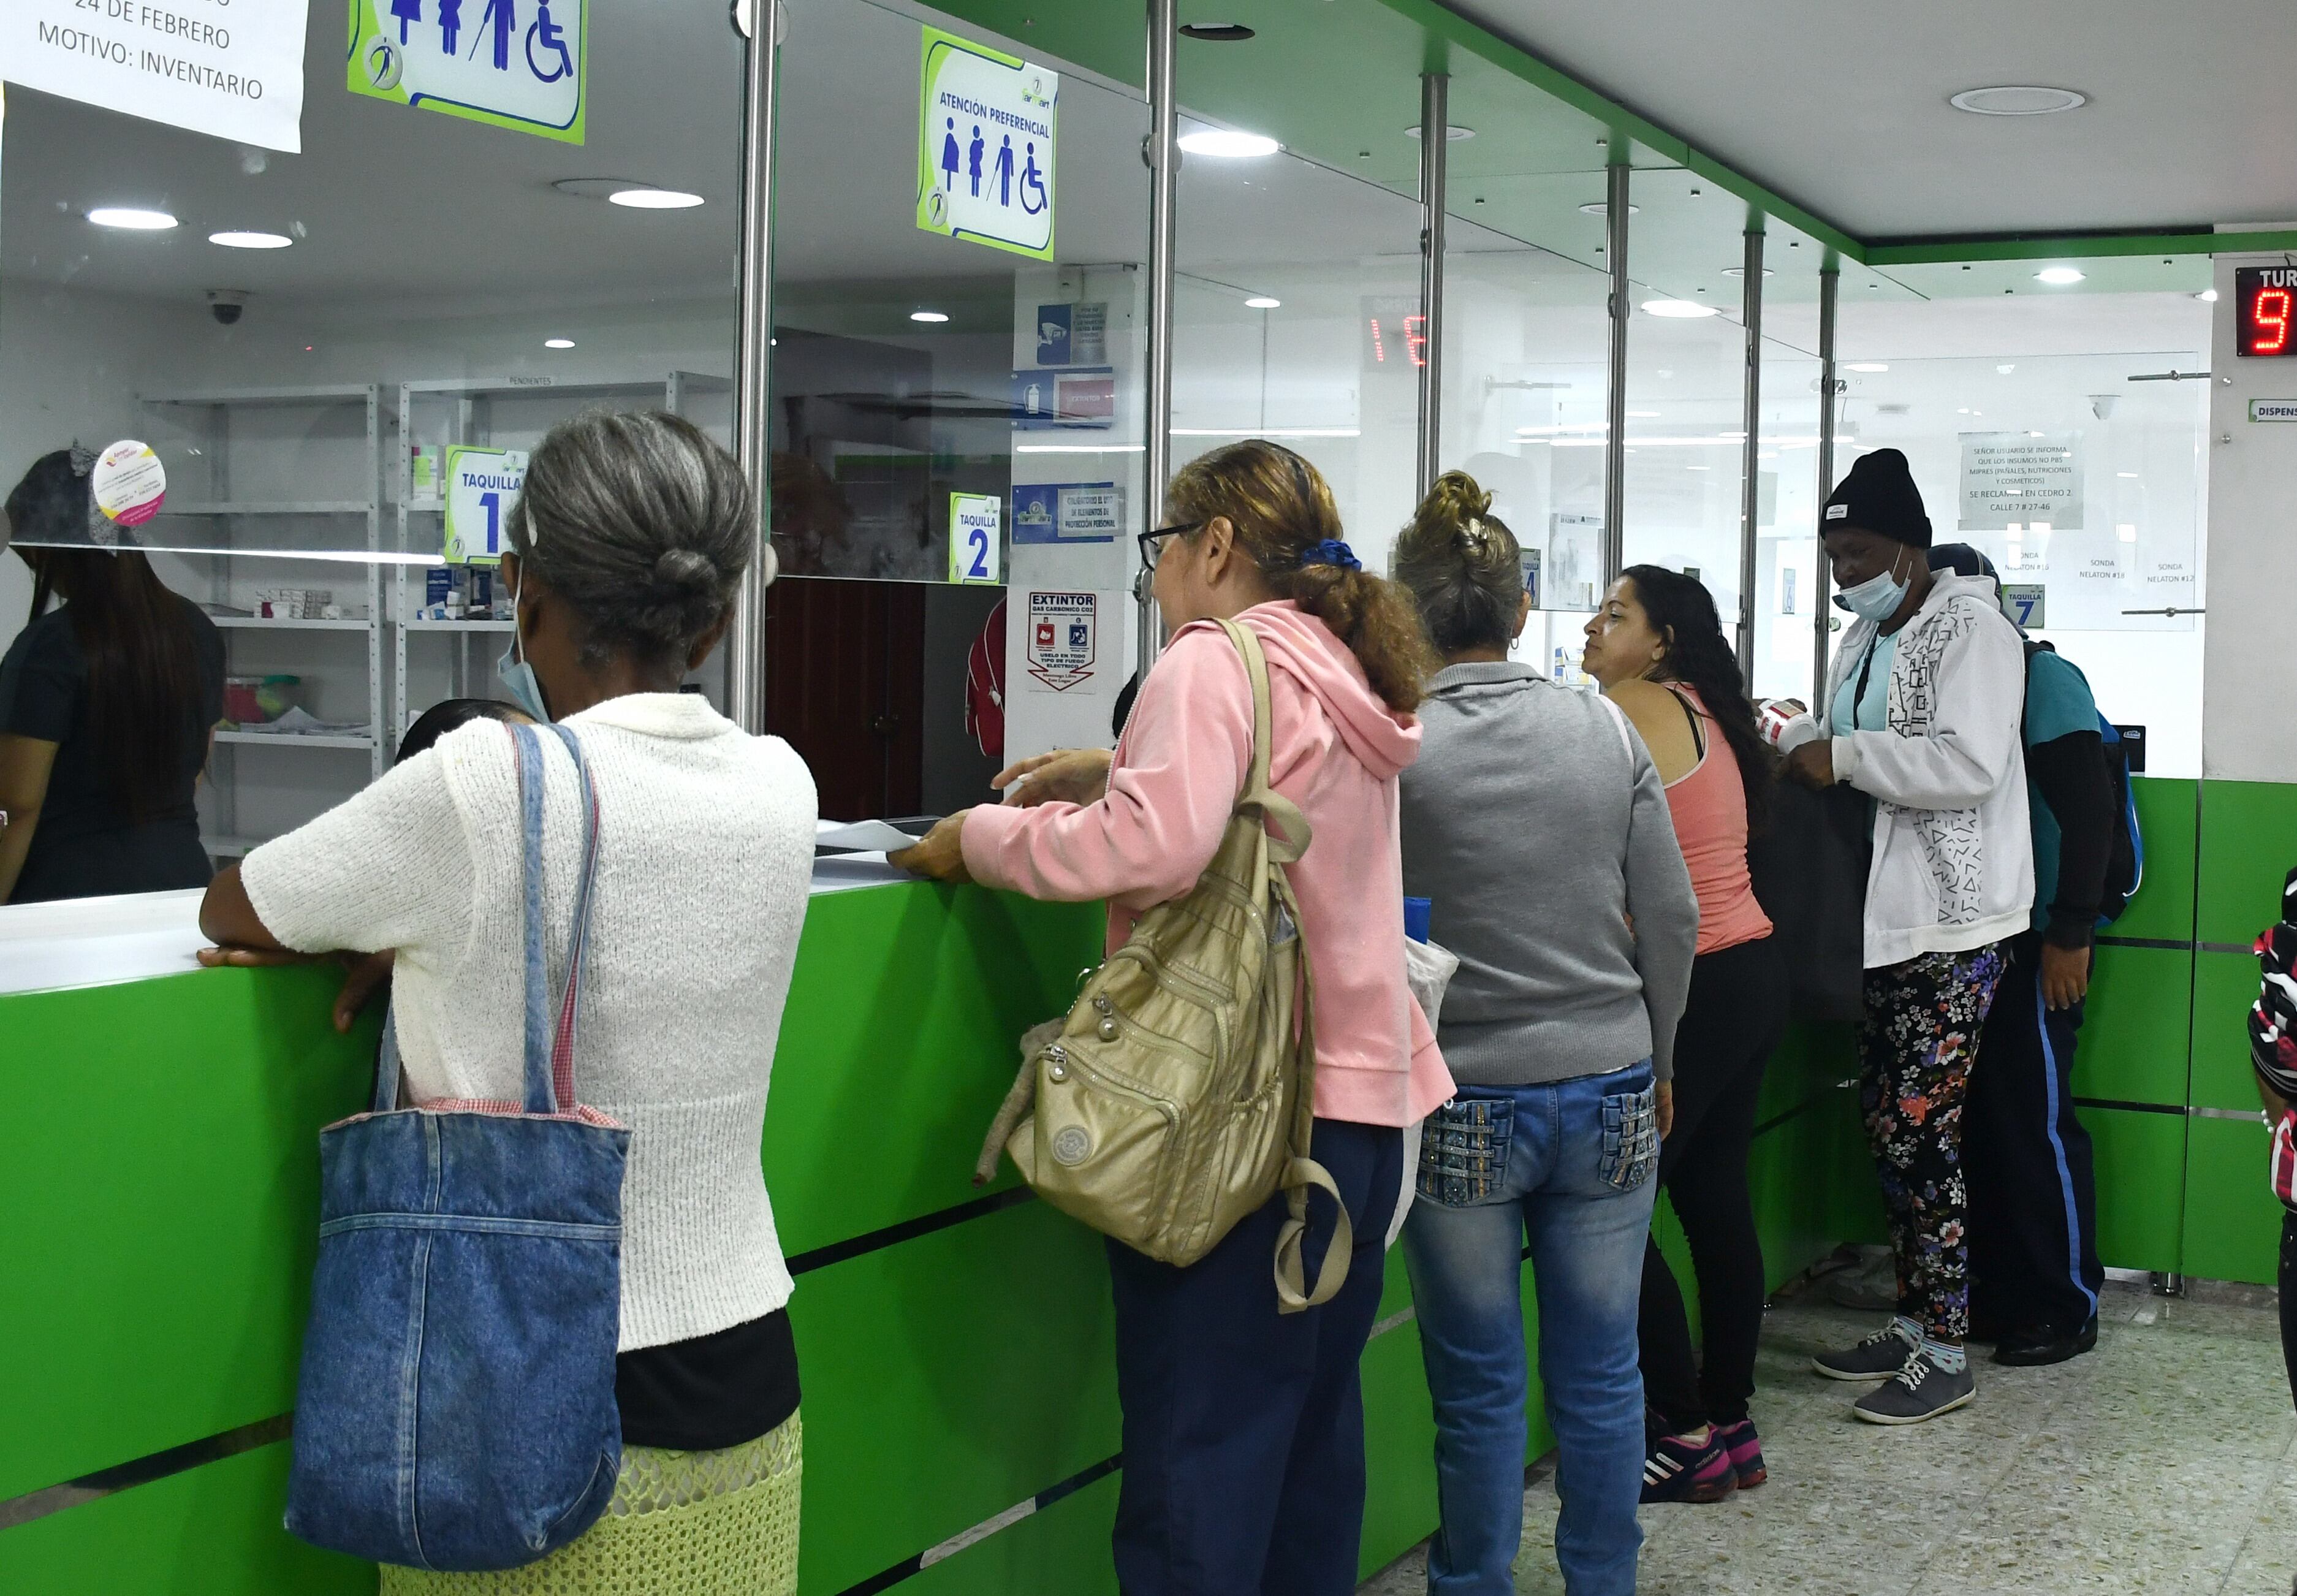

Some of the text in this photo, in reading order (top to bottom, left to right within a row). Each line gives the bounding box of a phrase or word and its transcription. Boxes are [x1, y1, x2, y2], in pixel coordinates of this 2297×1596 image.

[108, 0, 134, 22] DE
[142, 6, 229, 49] FEBRERO
[39, 21, 262, 99] MOTIVO: INVENTARIO
[940, 92, 1049, 139] ATENCIÓN PREFERENCIAL
[2259, 270, 2297, 287] TUR
[2256, 291, 2290, 349] 9
[463, 473, 521, 490] TAQUILLA
[479, 493, 499, 553] 1
[960, 514, 996, 528] TAQUILLA
[968, 529, 988, 577] 2
[1033, 595, 1093, 605] EXTINTOR
[2016, 601, 2034, 625] 7
